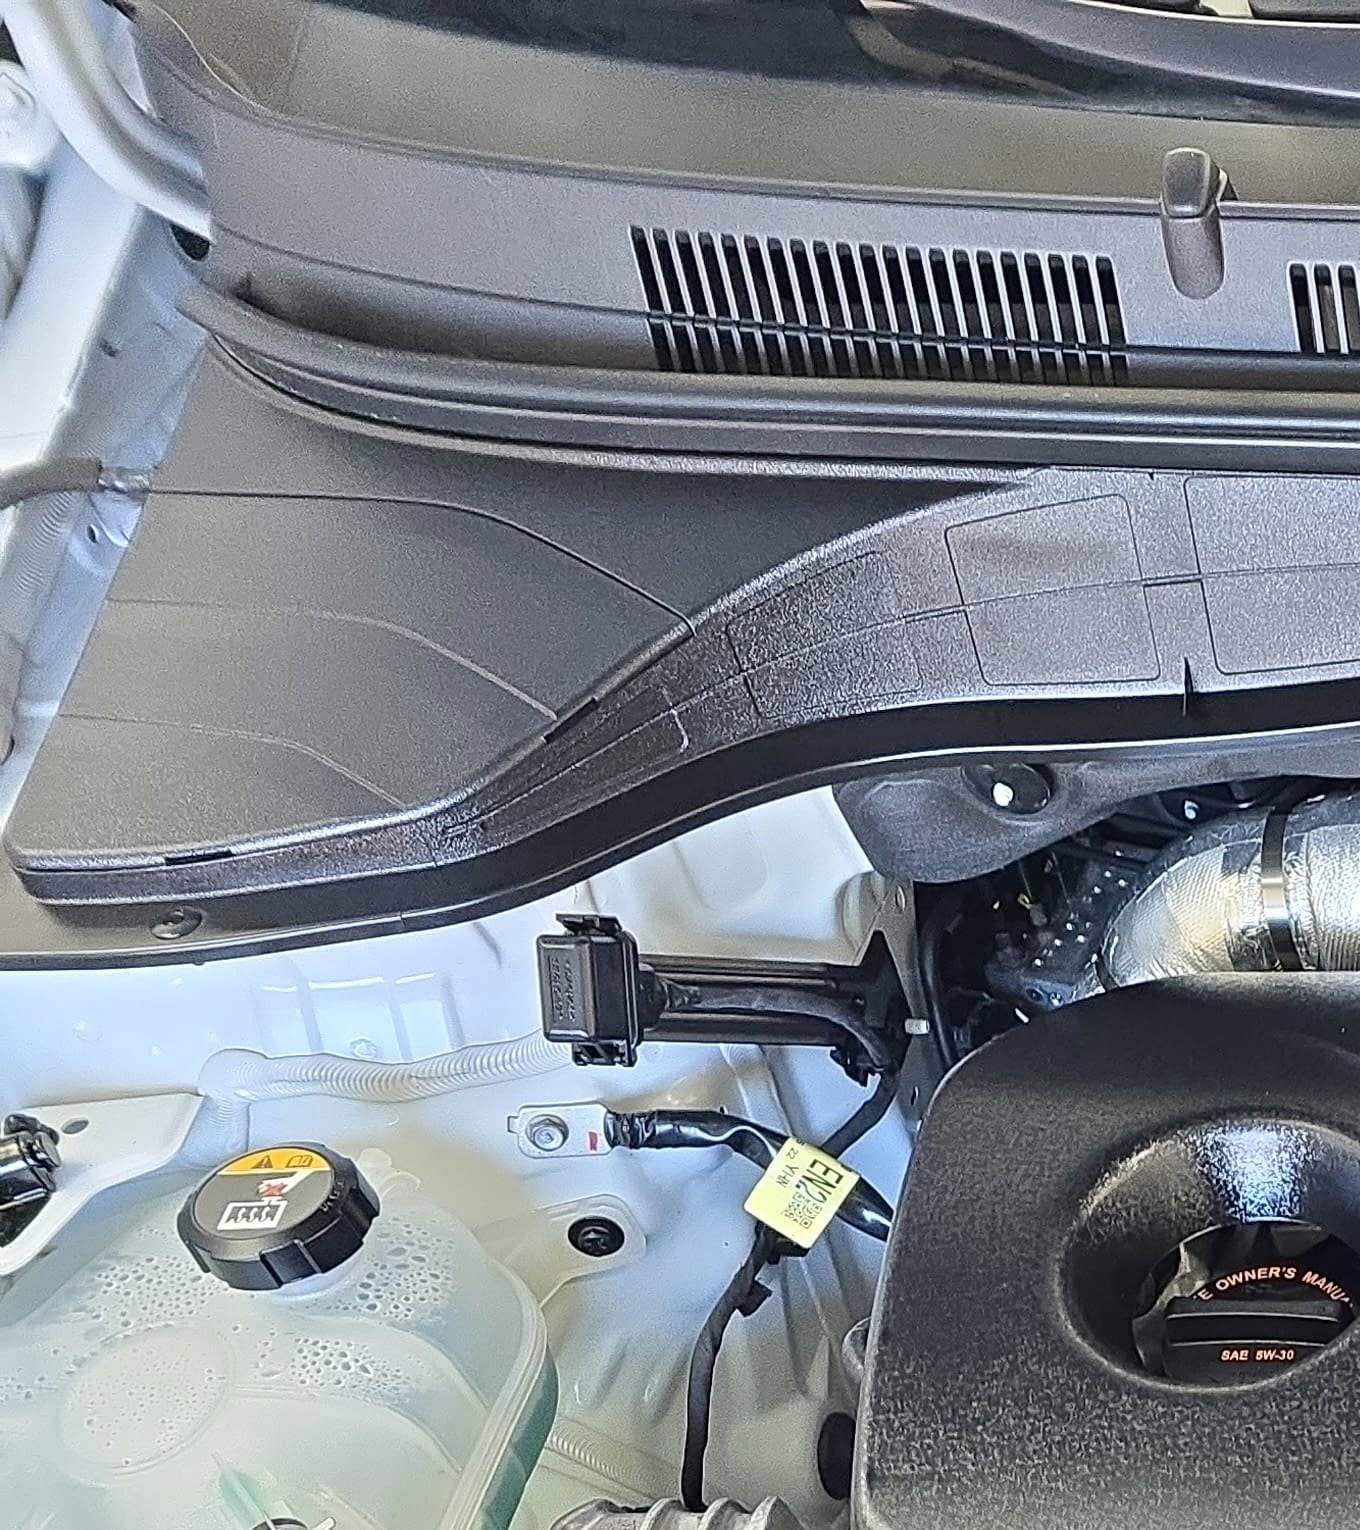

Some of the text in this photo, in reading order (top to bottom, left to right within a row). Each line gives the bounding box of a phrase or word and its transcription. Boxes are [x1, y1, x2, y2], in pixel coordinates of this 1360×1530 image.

[1215, 1266, 1297, 1291] OWNER'S
[1221, 1350, 1295, 1361] SAE 5W-30
